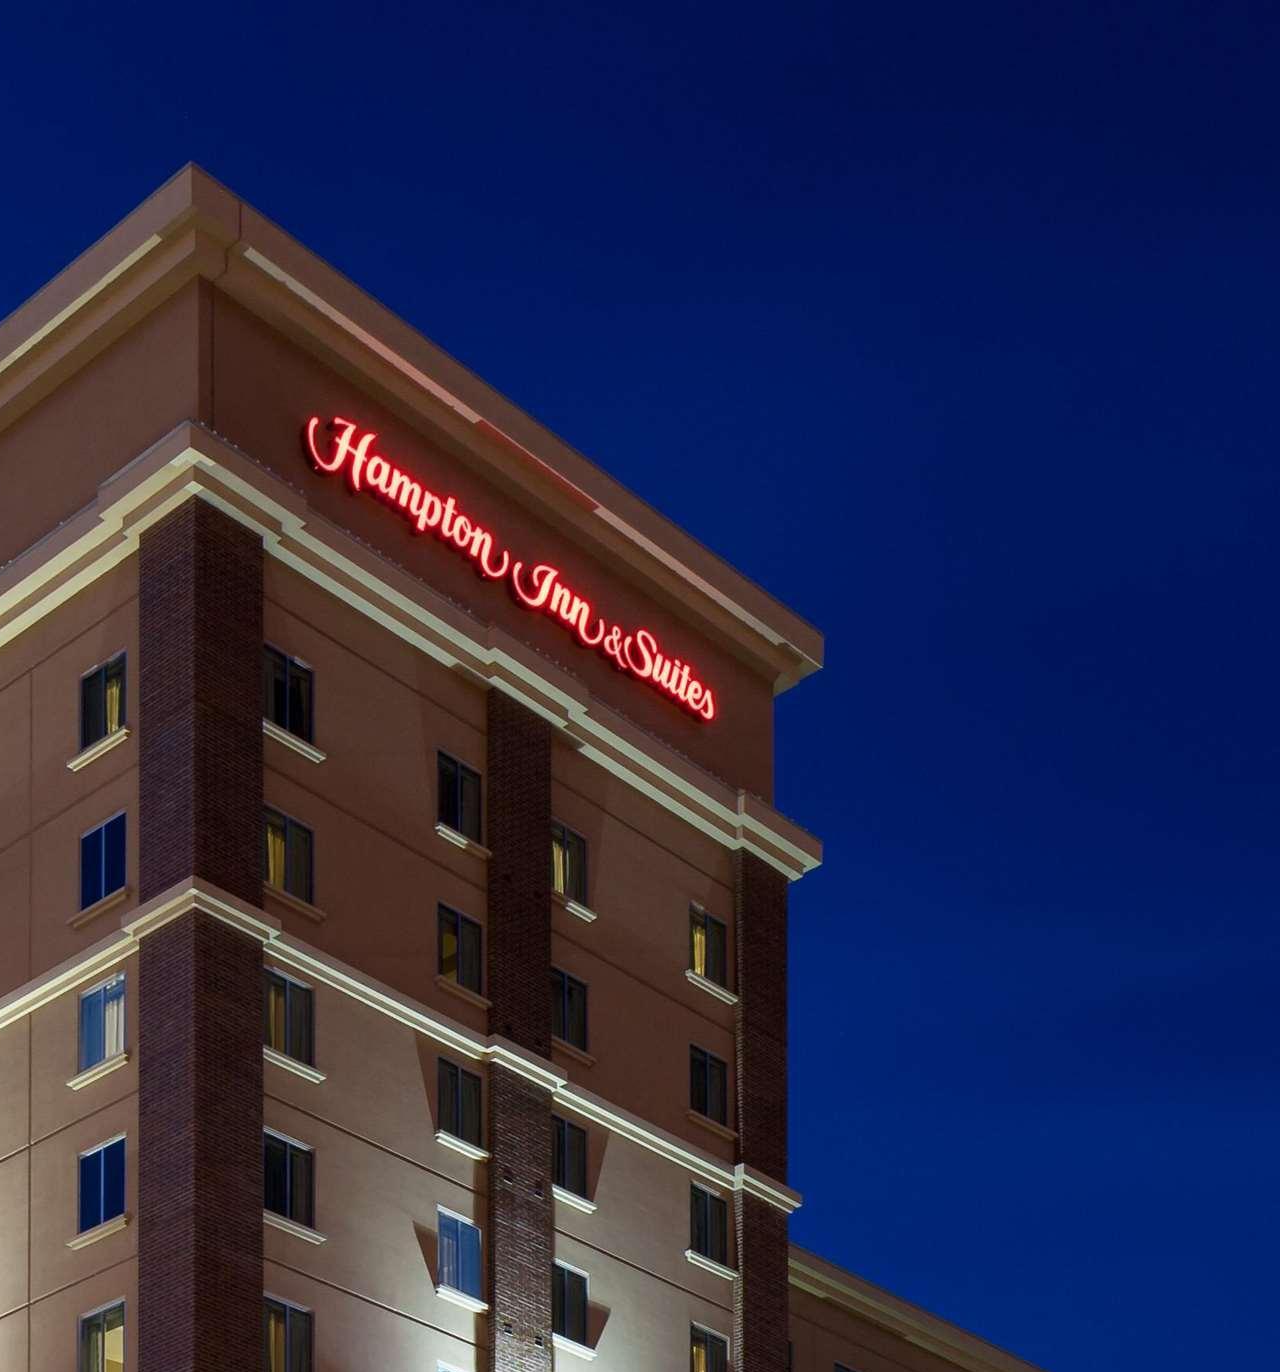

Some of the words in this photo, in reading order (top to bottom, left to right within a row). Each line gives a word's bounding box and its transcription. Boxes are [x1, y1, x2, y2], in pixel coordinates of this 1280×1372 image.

[307, 416, 509, 577] Hampton
[513, 562, 605, 644] Inn
[604, 625, 629, 669] &
[624, 629, 715, 720] Suites
